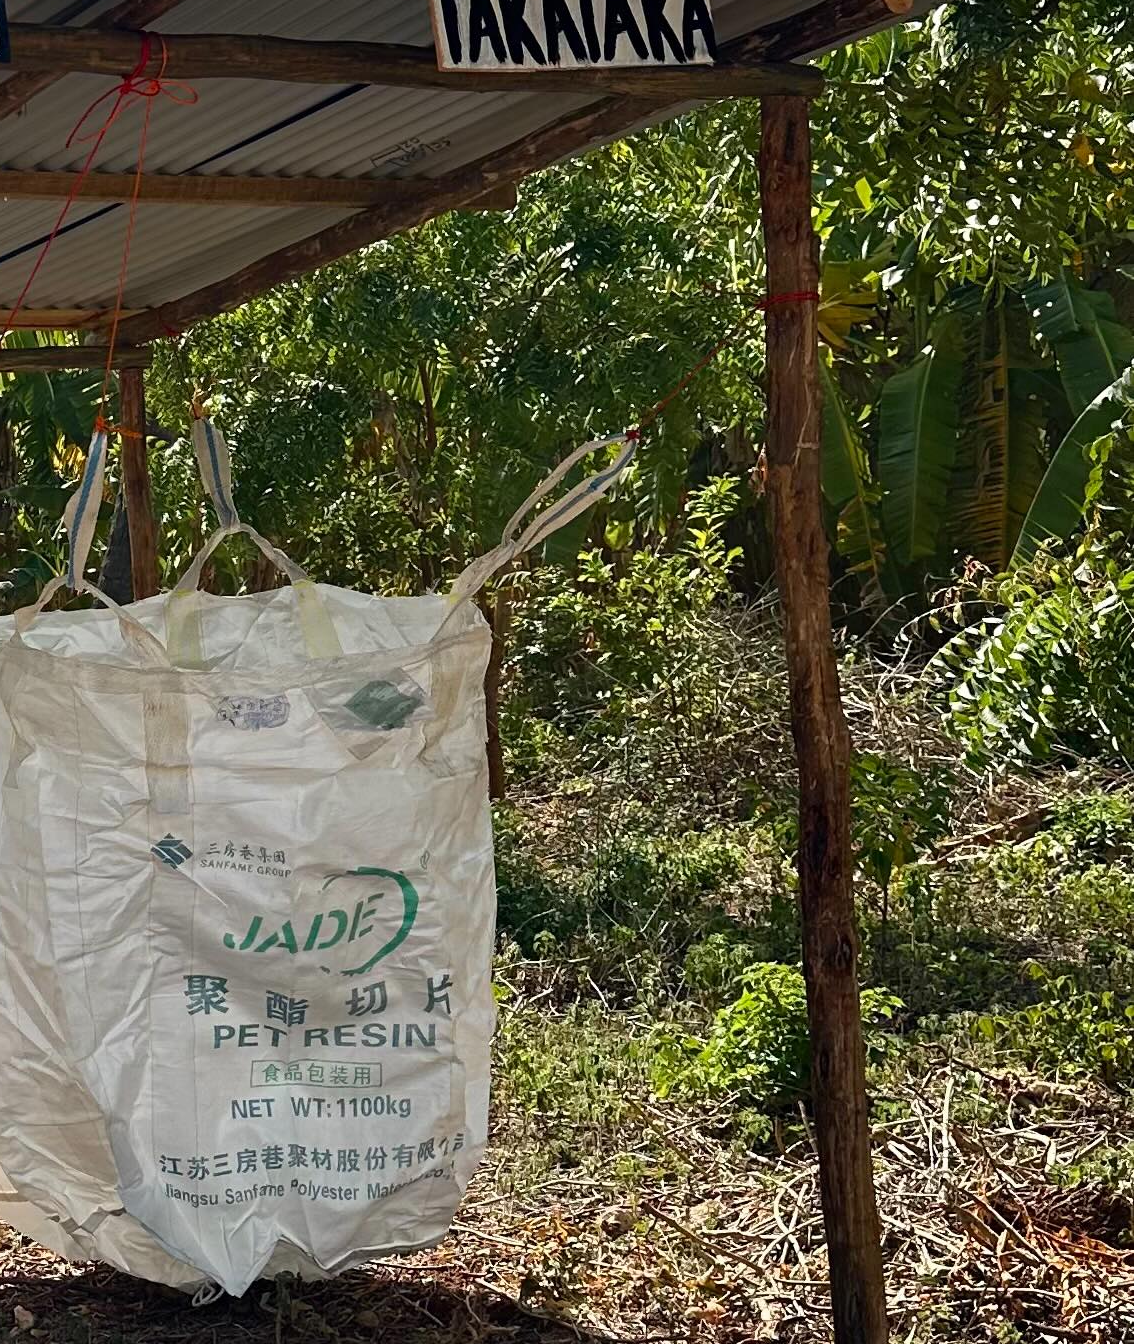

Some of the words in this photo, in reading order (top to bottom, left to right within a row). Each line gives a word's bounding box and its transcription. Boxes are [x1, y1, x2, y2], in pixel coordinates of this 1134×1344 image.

[200, 858, 254, 873] SANFAME
[256, 865, 292, 878] GROUP
[222, 892, 385, 955] JADE
[213, 1023, 288, 1049] PET
[303, 1022, 437, 1049] RESIN
[262, 1062, 372, 1085] 食品包装用
[230, 1097, 276, 1119] NET
